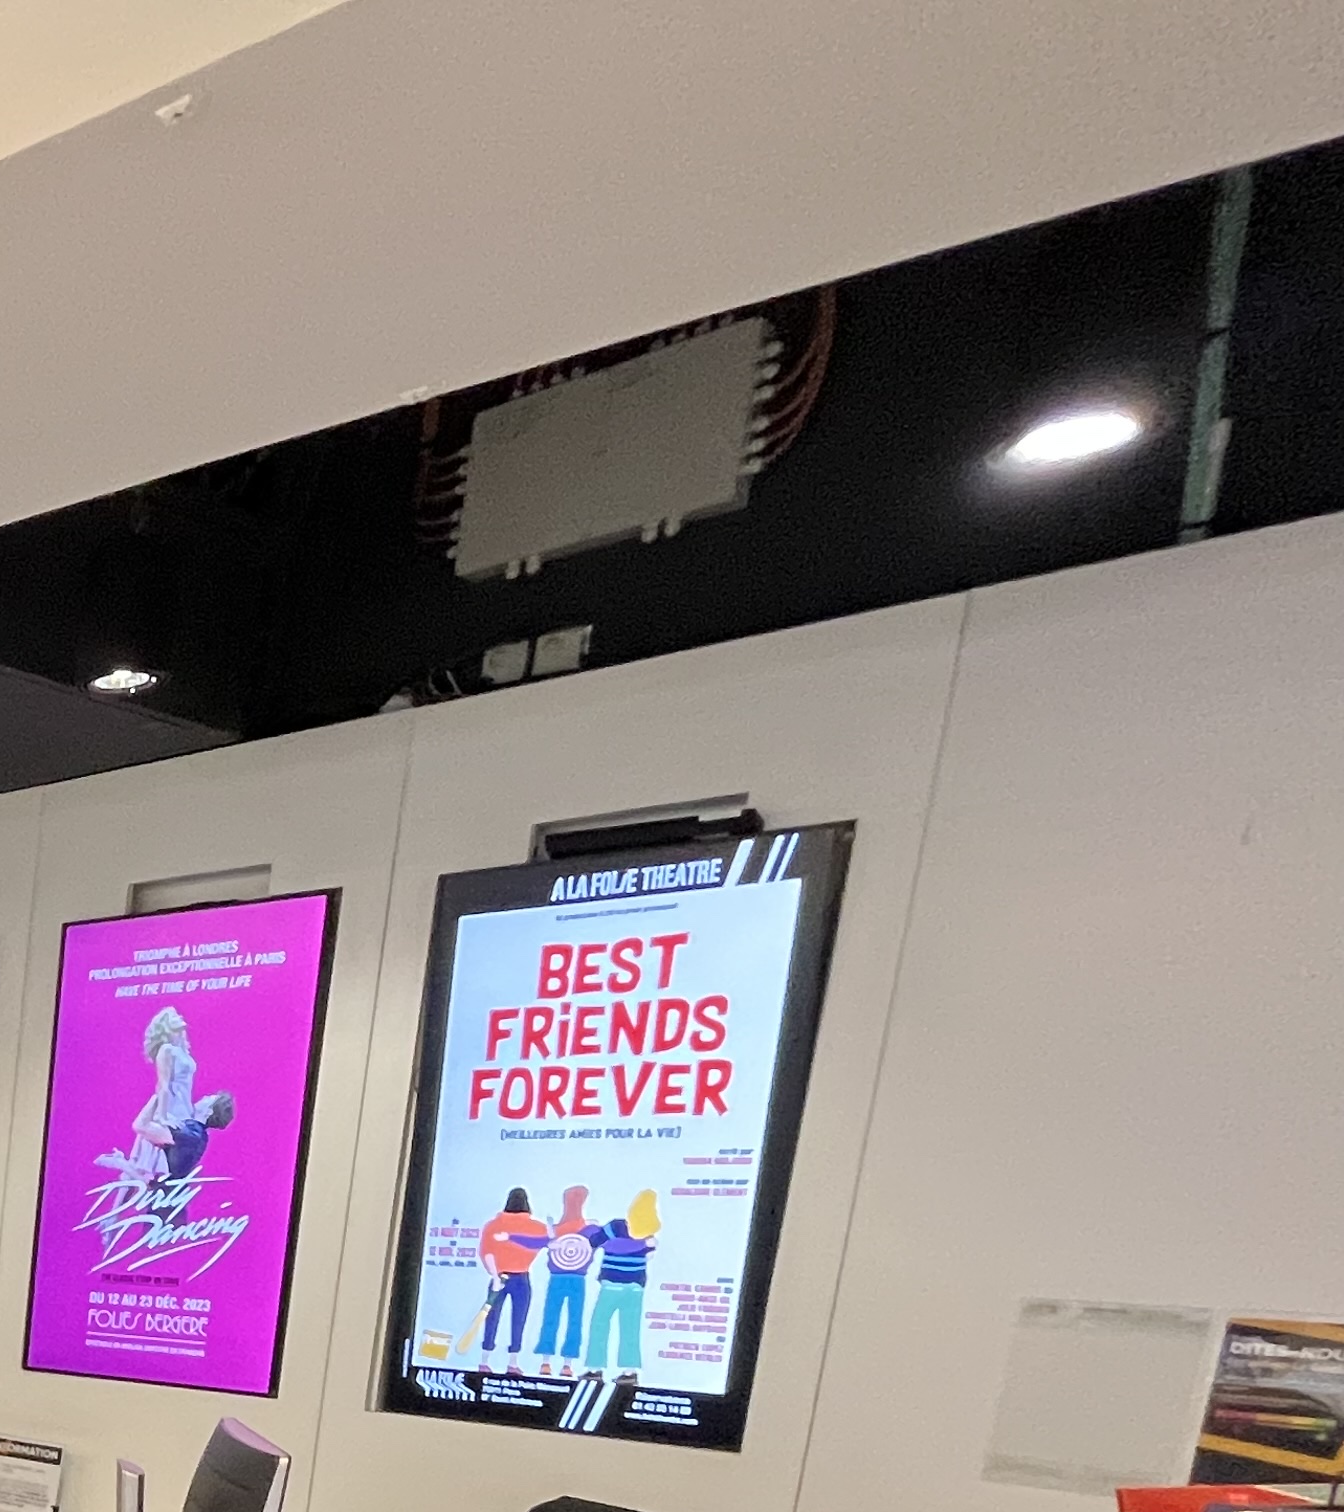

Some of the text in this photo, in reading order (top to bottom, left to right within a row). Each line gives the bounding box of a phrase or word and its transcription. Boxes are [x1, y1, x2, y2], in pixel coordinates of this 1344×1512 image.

[641, 858, 723, 890] THEATRE
[536, 931, 690, 999] BEST
[469, 1058, 733, 1120] FOREVER
[71, 1165, 234, 1231] Dirty
[88, 1201, 249, 1283] Dancing
[87, 1308, 143, 1330] FOLIES
[89, 1291, 104, 1304] DU
[108, 1293, 120, 1305] 12
[121, 1294, 137, 1306] AU
[139, 1295, 153, 1307] 23
[182, 1297, 211, 1312] 2023
